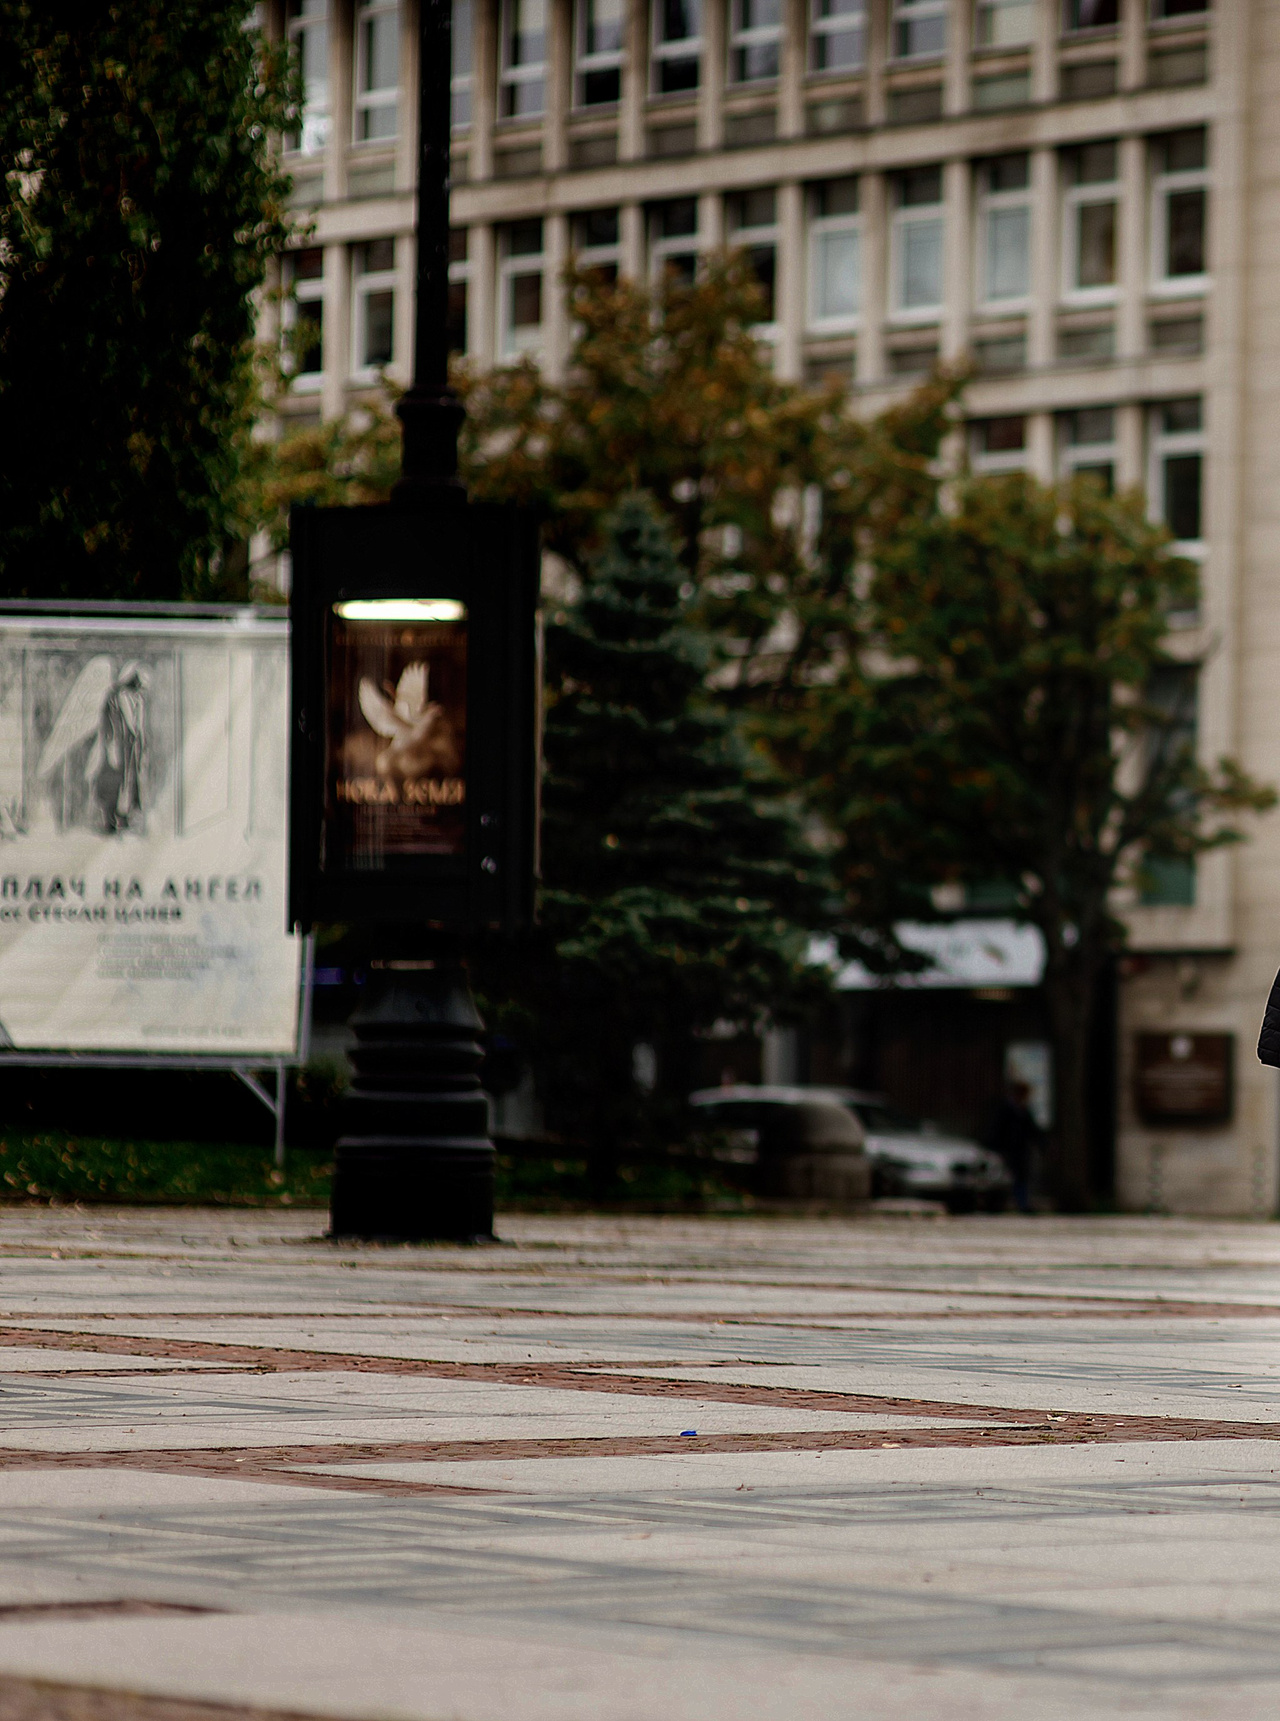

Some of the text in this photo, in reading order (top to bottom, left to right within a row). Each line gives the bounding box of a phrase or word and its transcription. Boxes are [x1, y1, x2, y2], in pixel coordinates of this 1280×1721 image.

[1, 874, 263, 903] ПЛАЧ НА АНГЕЛ
